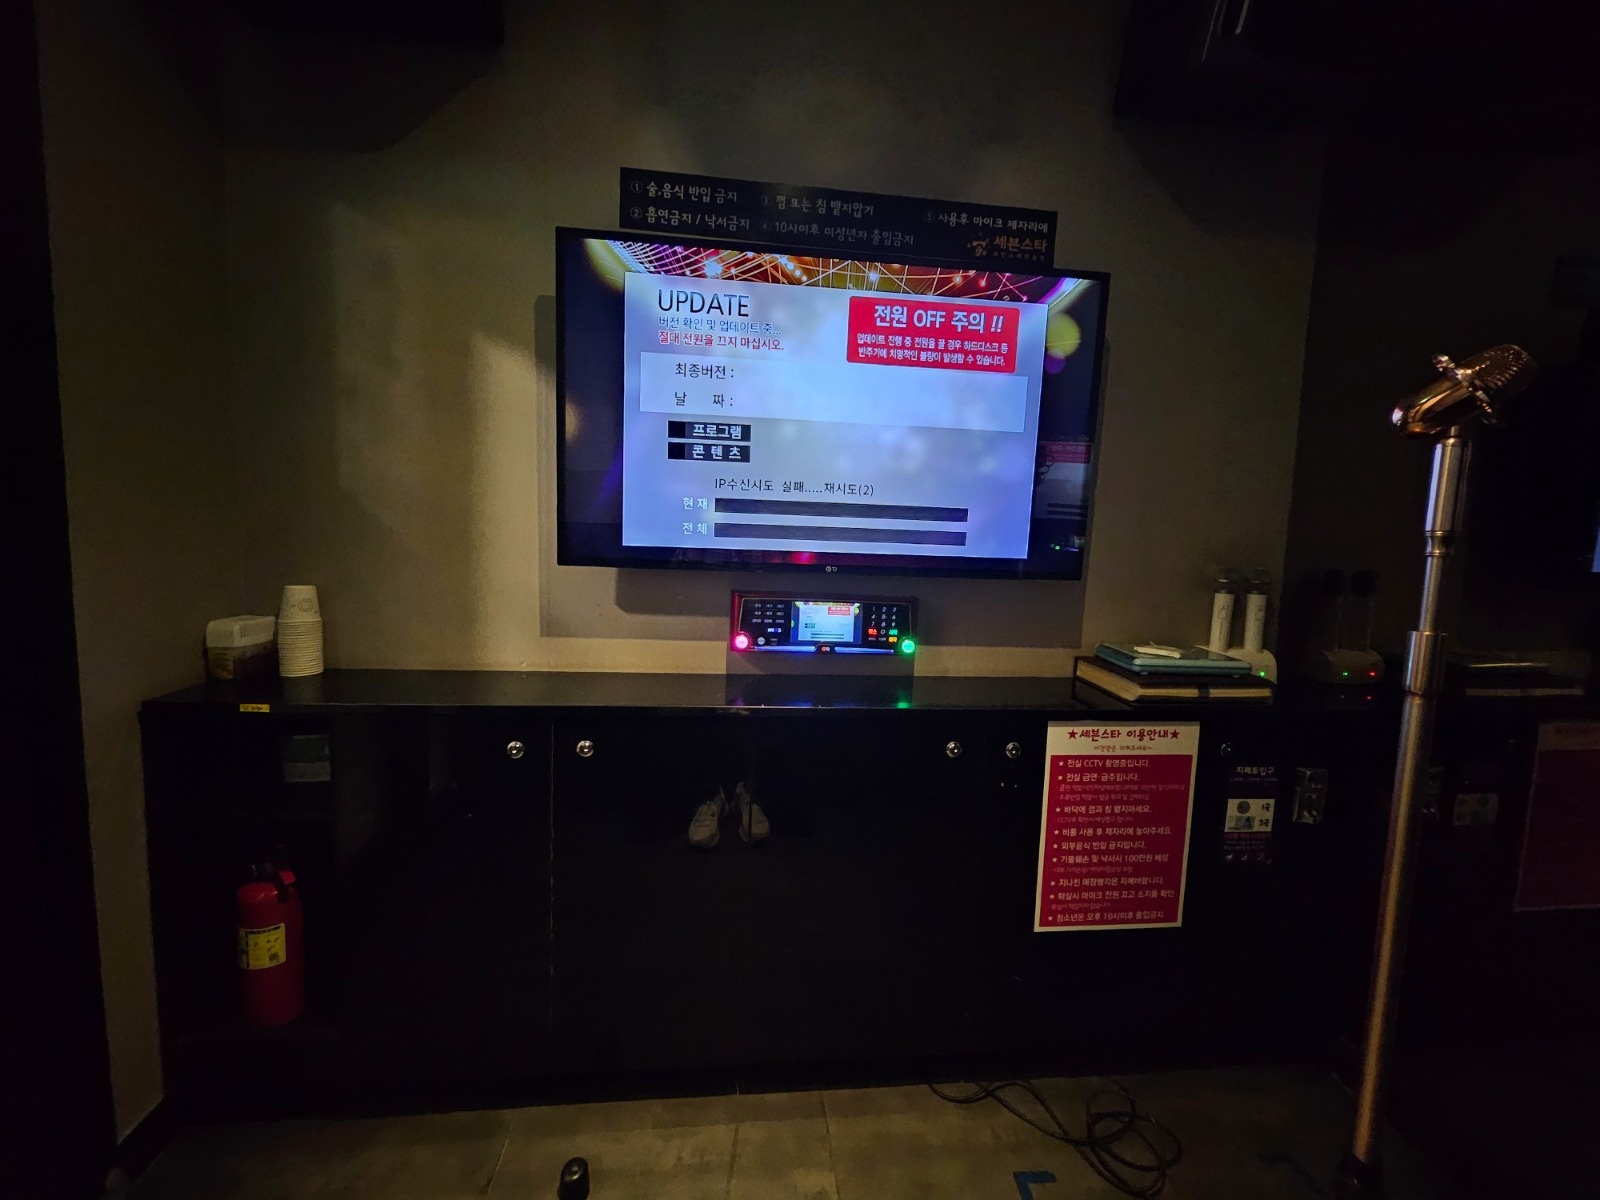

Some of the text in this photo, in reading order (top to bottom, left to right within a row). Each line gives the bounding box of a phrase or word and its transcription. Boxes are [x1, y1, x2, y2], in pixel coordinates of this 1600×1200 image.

[647, 182, 684, 200] 술,음식
[689, 186, 711, 202] 반입
[715, 189, 737, 203] 금지
[775, 195, 786, 210] 껌
[791, 197, 812, 212] 또는
[816, 198, 827, 214] 침
[646, 207, 692, 225] 흡연금지
[705, 214, 750, 230] 낙서금지
[938, 212, 969, 227] 사용후
[973, 216, 1003, 228] 마이크
[1007, 219, 1048, 233] 제자리에
[775, 221, 820, 235] 10시이후
[824, 225, 868, 242] 미성년자
[871, 228, 913, 246] 출입금지
[993, 234, 1048, 253] 세븐스타
[658, 289, 749, 317] UPDATE
[659, 316, 680, 326] 버전
[683, 318, 703, 331] 확인
[706, 319, 716, 331] 및
[719, 321, 760, 335] 업데이트
[874, 305, 907, 327] 전원
[913, 310, 946, 329] OFF
[951, 311, 985, 334] 주의
[659, 331, 784, 351] 절대 전원을 끄지 마십시오.
[857, 333, 886, 345] 업데이트
[888, 336, 902, 347] 진행
[904, 336, 912, 347] 중
[914, 337, 936, 349] 전원을
[947, 339, 962, 351] 경우
[963, 340, 999, 352] 하드디스크
[1000, 342, 1009, 354] 등
[858, 346, 1006, 367] 반주기에 치명적인 불량이 발생할 수 있습니다.
[674, 362, 726, 380] 최종버전
[692, 423, 742, 440] 프로그램
[714, 478, 774, 492] IP수신시도
[1079, 728, 1169, 742] 세븐스타 이용안내
[1067, 759, 1083, 768] 전실
[1084, 759, 1104, 767] CCTV
[1066, 773, 1081, 781] 전실
[1064, 805, 1086, 814] 바닥에
[1088, 805, 1103, 814] 껌과
[1105, 805, 1112, 814] 침
[1062, 828, 1077, 837] 비품
[1079, 827, 1094, 836] 사용
[1095, 827, 1103, 836] 후
[1105, 827, 1134, 836] 제자리에
[1061, 841, 1091, 851] 외부음식
[1092, 841, 1107, 850] 반입
[1100, 854, 1123, 863] 낙서시
[1124, 854, 1153, 863] 100만원
[1155, 853, 1169, 863] 배상
[1058, 878, 1080, 887] 지나친
[1082, 878, 1119, 887] 애정행각은
[1058, 892, 1080, 901] 퇴실시
[1081, 891, 1103, 900] 마이크
[1105, 890, 1120, 899] 전원
[1121, 890, 1135, 899] 끄고
[1160, 889, 1175, 898] 확인
[1056, 911, 1164, 922] 청소년은 오후 10시이후 출입금지
